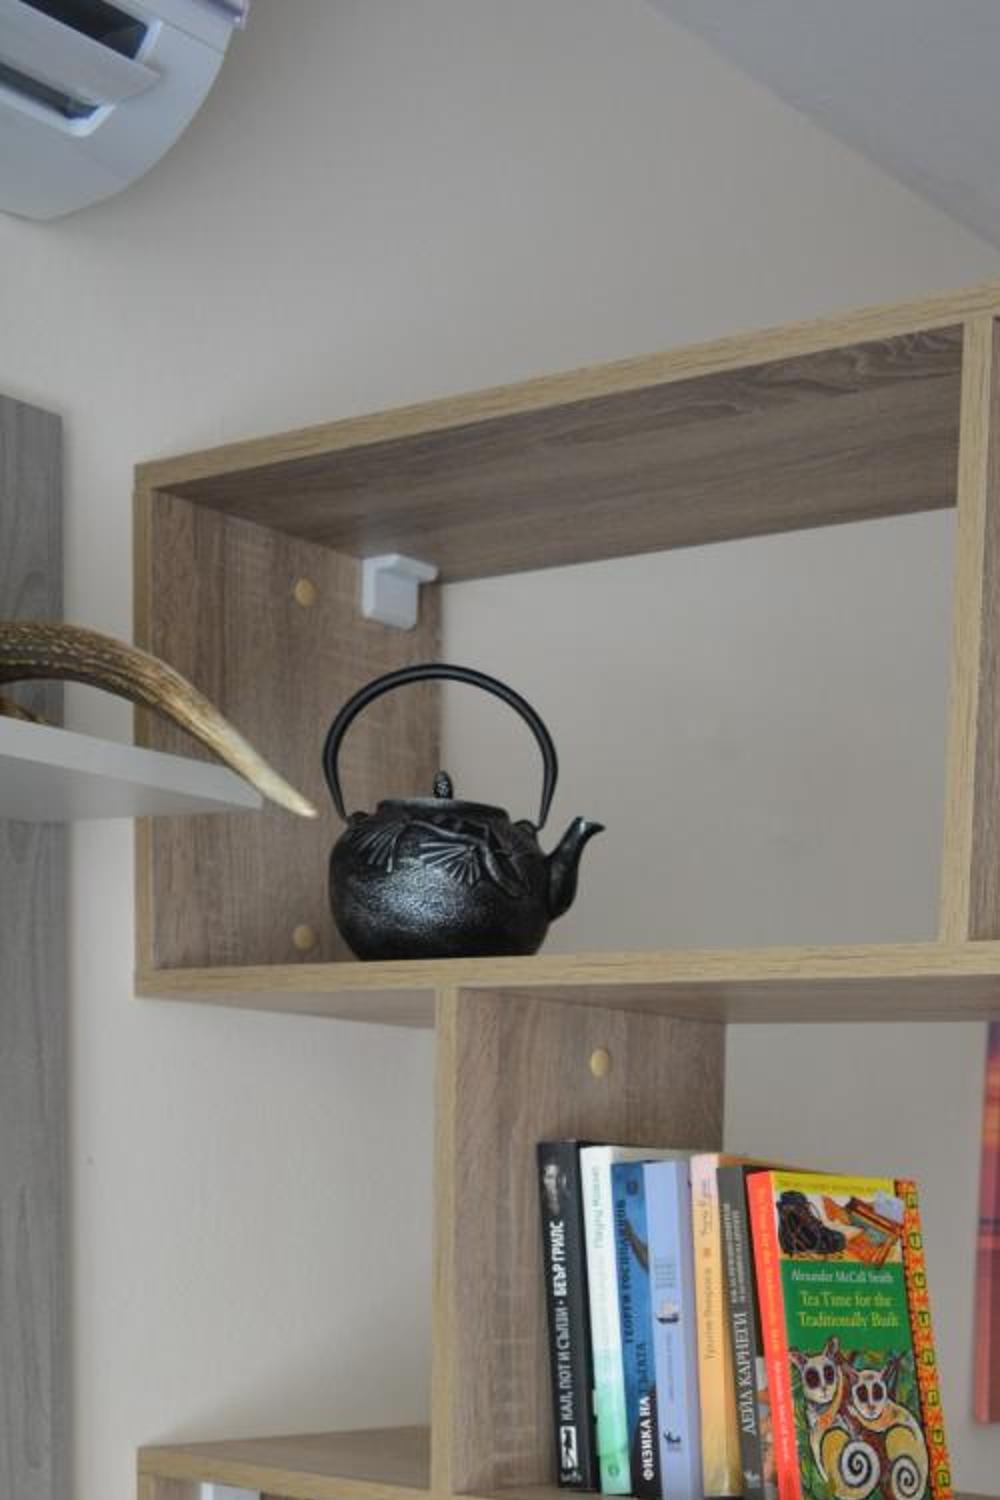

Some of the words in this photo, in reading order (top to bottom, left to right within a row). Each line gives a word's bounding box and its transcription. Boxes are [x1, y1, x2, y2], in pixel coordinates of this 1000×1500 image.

[550, 1219, 566, 1261] ГРИЛС
[552, 1262, 568, 1297] БЕЪР
[791, 1269, 832, 1281] Alexander
[835, 1269, 865, 1282] McCall
[868, 1272, 893, 1283] Smith
[800, 1290, 819, 1306] Tea
[821, 1292, 851, 1306] Time
[855, 1292, 871, 1306] for
[873, 1292, 893, 1306] the
[798, 1311, 868, 1328] Traditionally
[871, 1312, 899, 1327] Built
[557, 1351, 571, 1361] И
[731, 1311, 752, 1386] КАРНЕГИ
[557, 1364, 573, 1388] ПОТ
[638, 1395, 650, 1416] НА
[737, 1388, 756, 1435] ДЕЙЛ
[639, 1418, 654, 1480] ФИЗИКА
